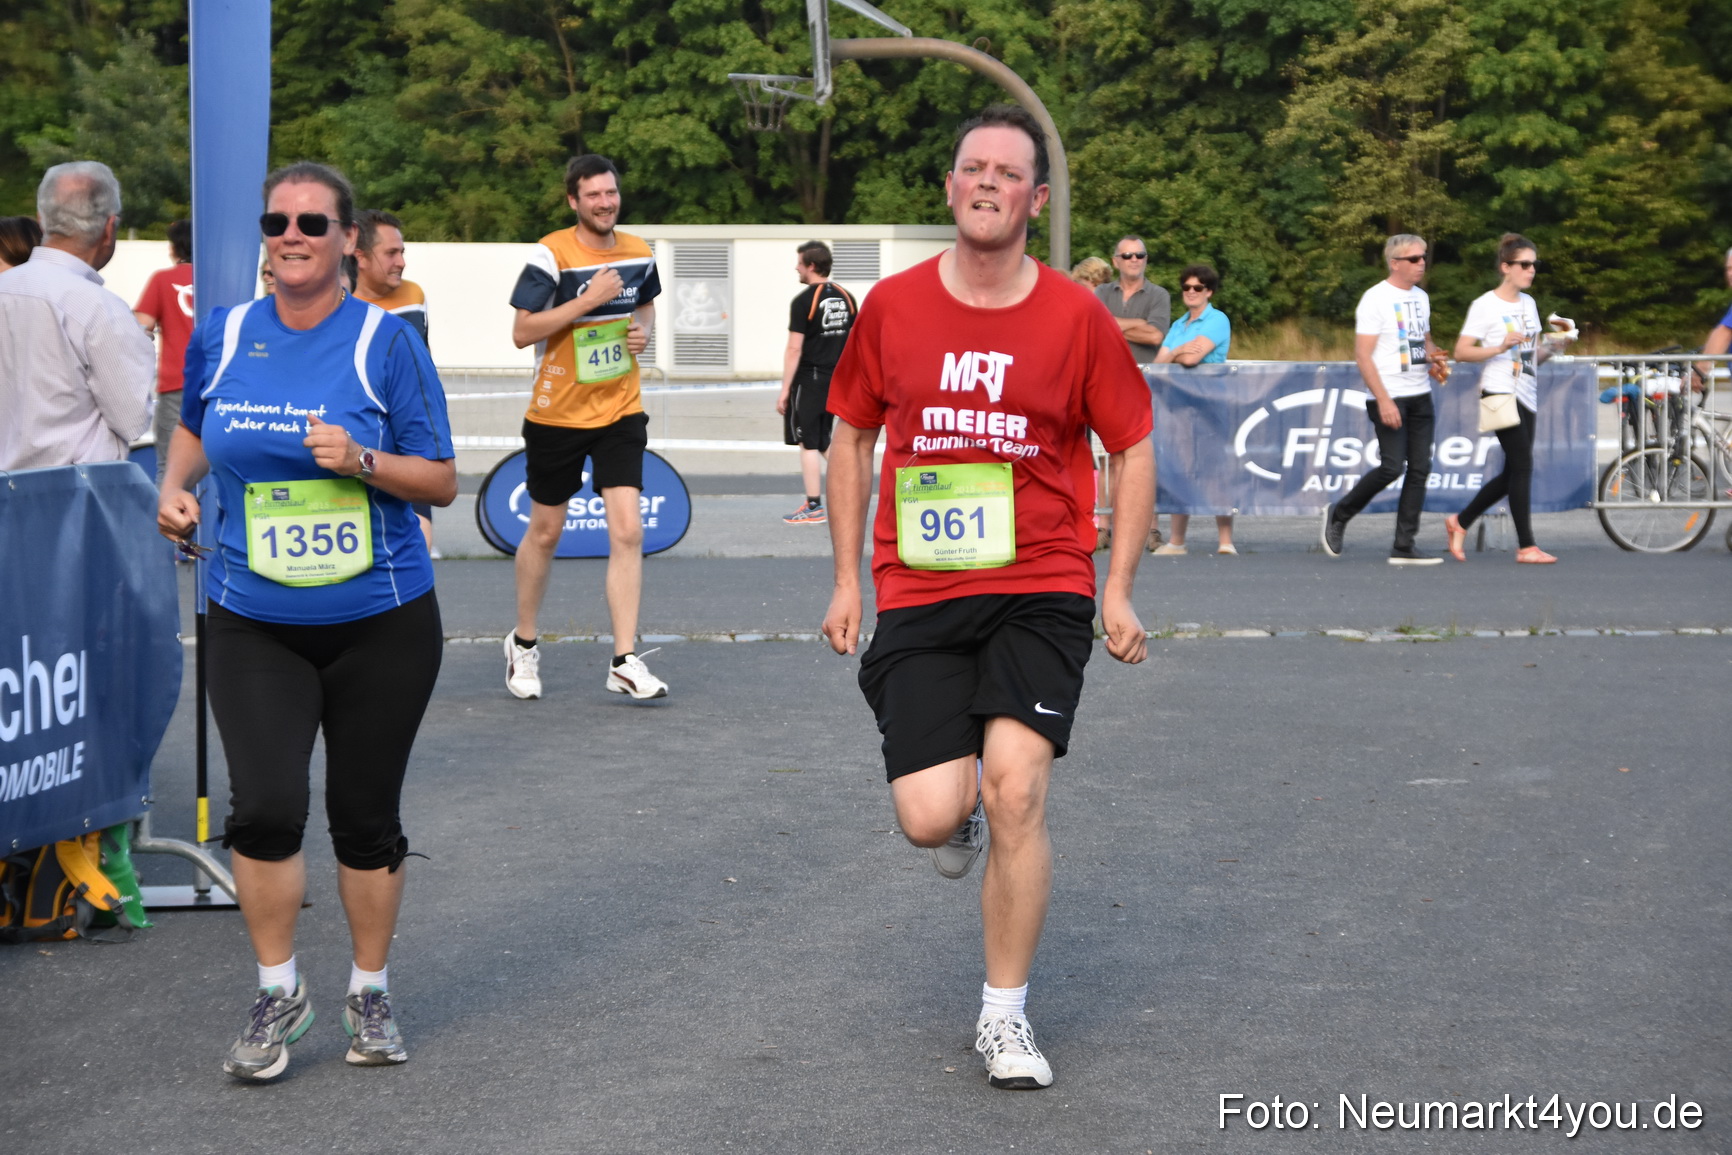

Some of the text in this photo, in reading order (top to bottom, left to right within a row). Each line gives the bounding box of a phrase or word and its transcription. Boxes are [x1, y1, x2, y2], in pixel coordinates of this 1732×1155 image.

[588, 344, 622, 366] 418
[939, 350, 1014, 403] MRT
[214, 398, 327, 417] Irgendwann kommt
[224, 417, 267, 433] jeder
[268, 421, 300, 433] nach
[922, 407, 1028, 439] MEIER
[989, 437, 1040, 457] Team
[920, 506, 985, 542] 961
[261, 521, 359, 558] 1356
[934, 548, 957, 556] Günter
[286, 564, 317, 572] Manuela
